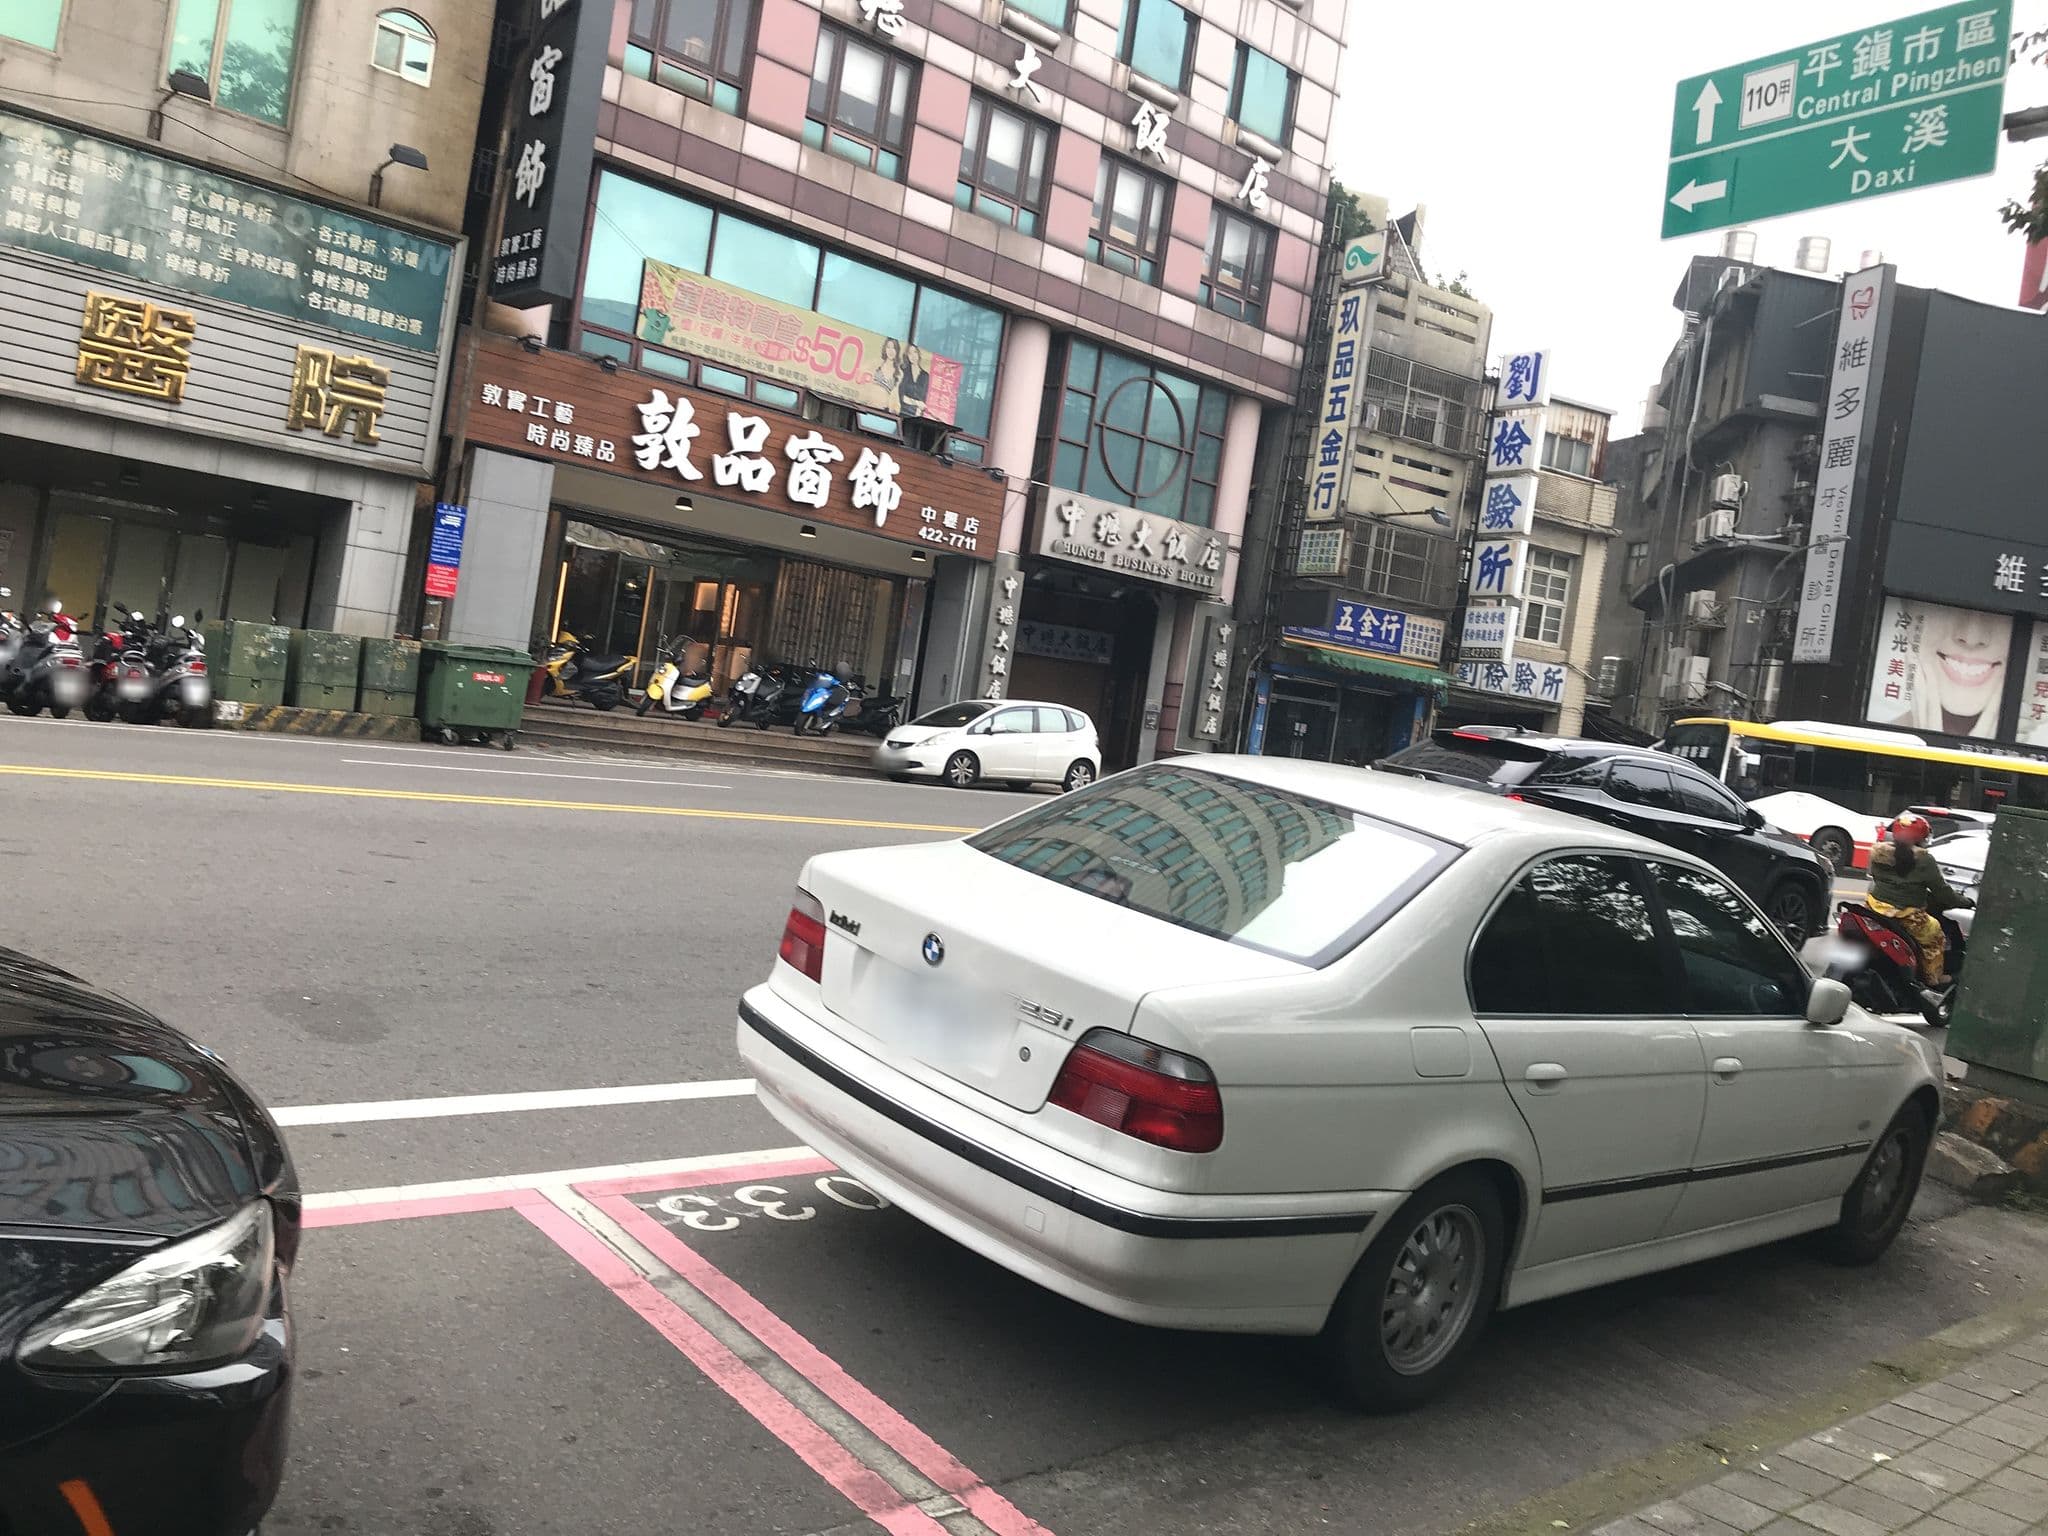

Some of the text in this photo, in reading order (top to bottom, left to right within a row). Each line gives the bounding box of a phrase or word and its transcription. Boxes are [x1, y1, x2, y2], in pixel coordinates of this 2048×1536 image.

[1802, 9, 1998, 88] 平鎮市區
[1746, 78, 1791, 113] 110甲
[1798, 54, 2001, 120] Central Pingzhen
[1829, 103, 1949, 170] 大溪
[1850, 159, 1916, 195] Daxi
[1313, 296, 1361, 511] 玖品五金行
[526, 422, 616, 463] 時尚臻品
[631, 388, 902, 528] 敦品窗飾
[1476, 352, 1542, 593] 劉檢驗所
[920, 506, 980, 535] 中壢店
[1832, 485, 1850, 540] Victori
[918, 528, 977, 551] 422-7711
[1115, 555, 1174, 577] BUSINESS
[1179, 570, 1216, 588] HOTEL
[1827, 549, 1839, 598] Dental
[1335, 605, 1401, 644] 五金行
[1816, 603, 1832, 647] Clinic
